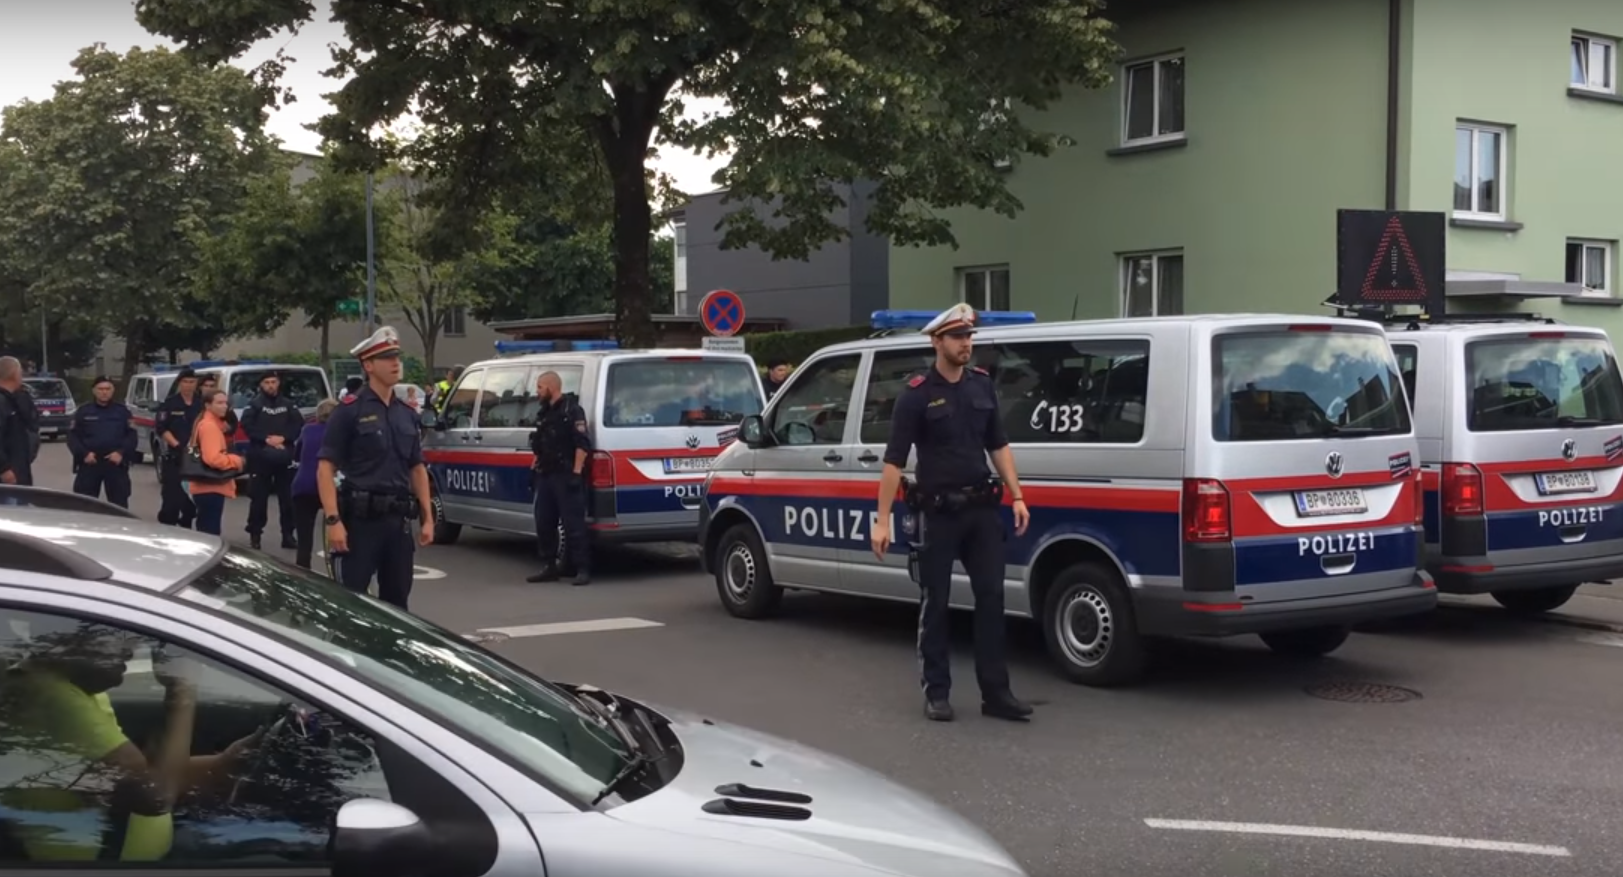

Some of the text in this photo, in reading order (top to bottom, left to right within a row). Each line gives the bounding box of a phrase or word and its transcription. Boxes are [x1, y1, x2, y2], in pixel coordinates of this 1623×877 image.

[1048, 405, 1083, 432] 133
[446, 468, 489, 493] POLIZEI
[664, 484, 701, 498] POLI
[1539, 507, 1603, 527] POLIZEI
[1298, 531, 1375, 556] POLIZEI
